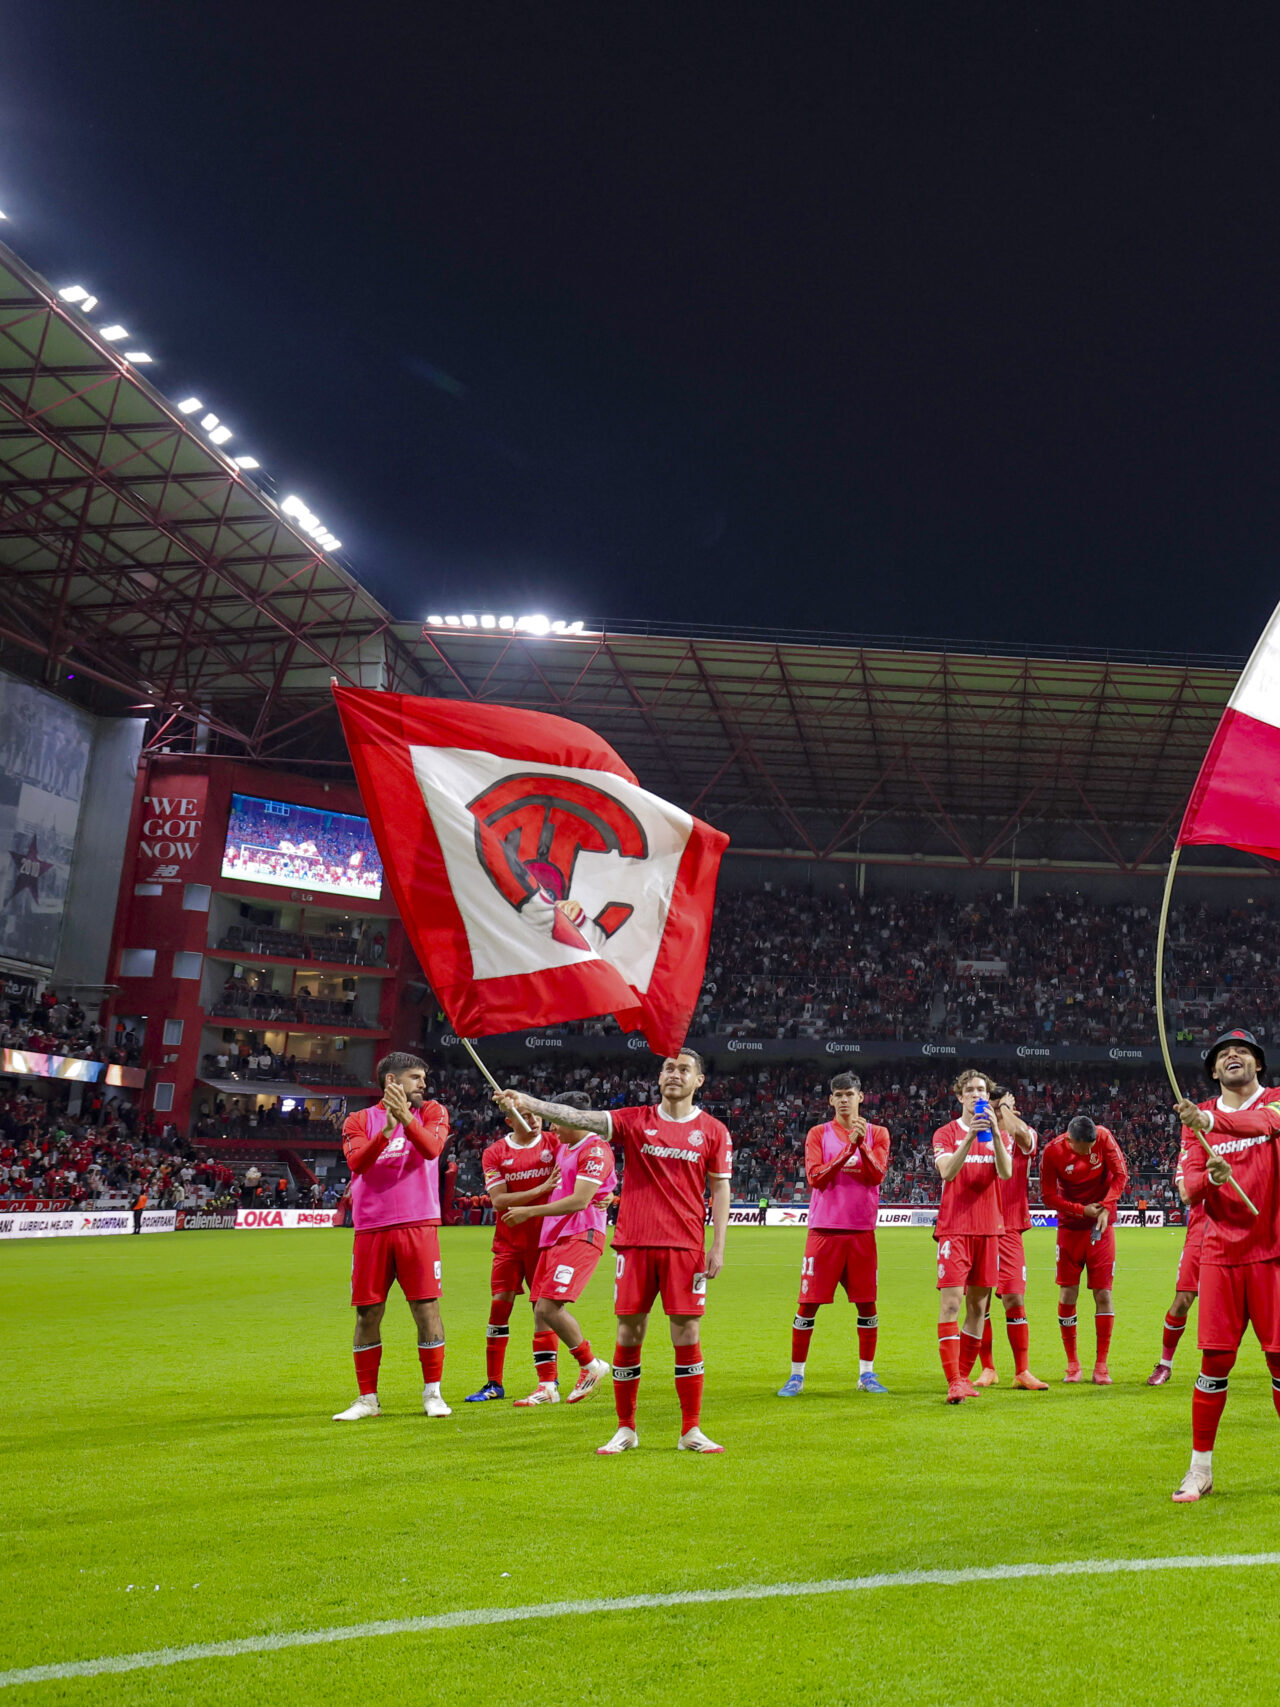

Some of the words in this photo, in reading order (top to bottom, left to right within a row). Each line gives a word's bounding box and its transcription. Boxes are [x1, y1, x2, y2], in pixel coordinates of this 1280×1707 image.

[152, 798, 198, 817] WE
[143, 819, 201, 839] GOT
[138, 841, 200, 860] NOW
[20, 858, 41, 878] 2010
[440, 1034, 478, 1046] Corna
[525, 1036, 562, 1048] Corona
[627, 1038, 650, 1050] Cor
[727, 1040, 763, 1052] Corona
[825, 1041, 861, 1054] Corona
[922, 1043, 956, 1056] Corona
[1016, 1046, 1050, 1057] Corona
[1109, 1048, 1143, 1059] Corona
[640, 1143, 701, 1163] ROSHFRANS
[585, 1161, 604, 1171] Red
[19, 1220, 49, 1231] LUBRICA
[50, 1219, 74, 1231] MEJOR
[91, 1218, 129, 1229] ROSHFRANS
[183, 1211, 236, 1229] caliente.mx
[236, 1211, 284, 1227] LOKA
